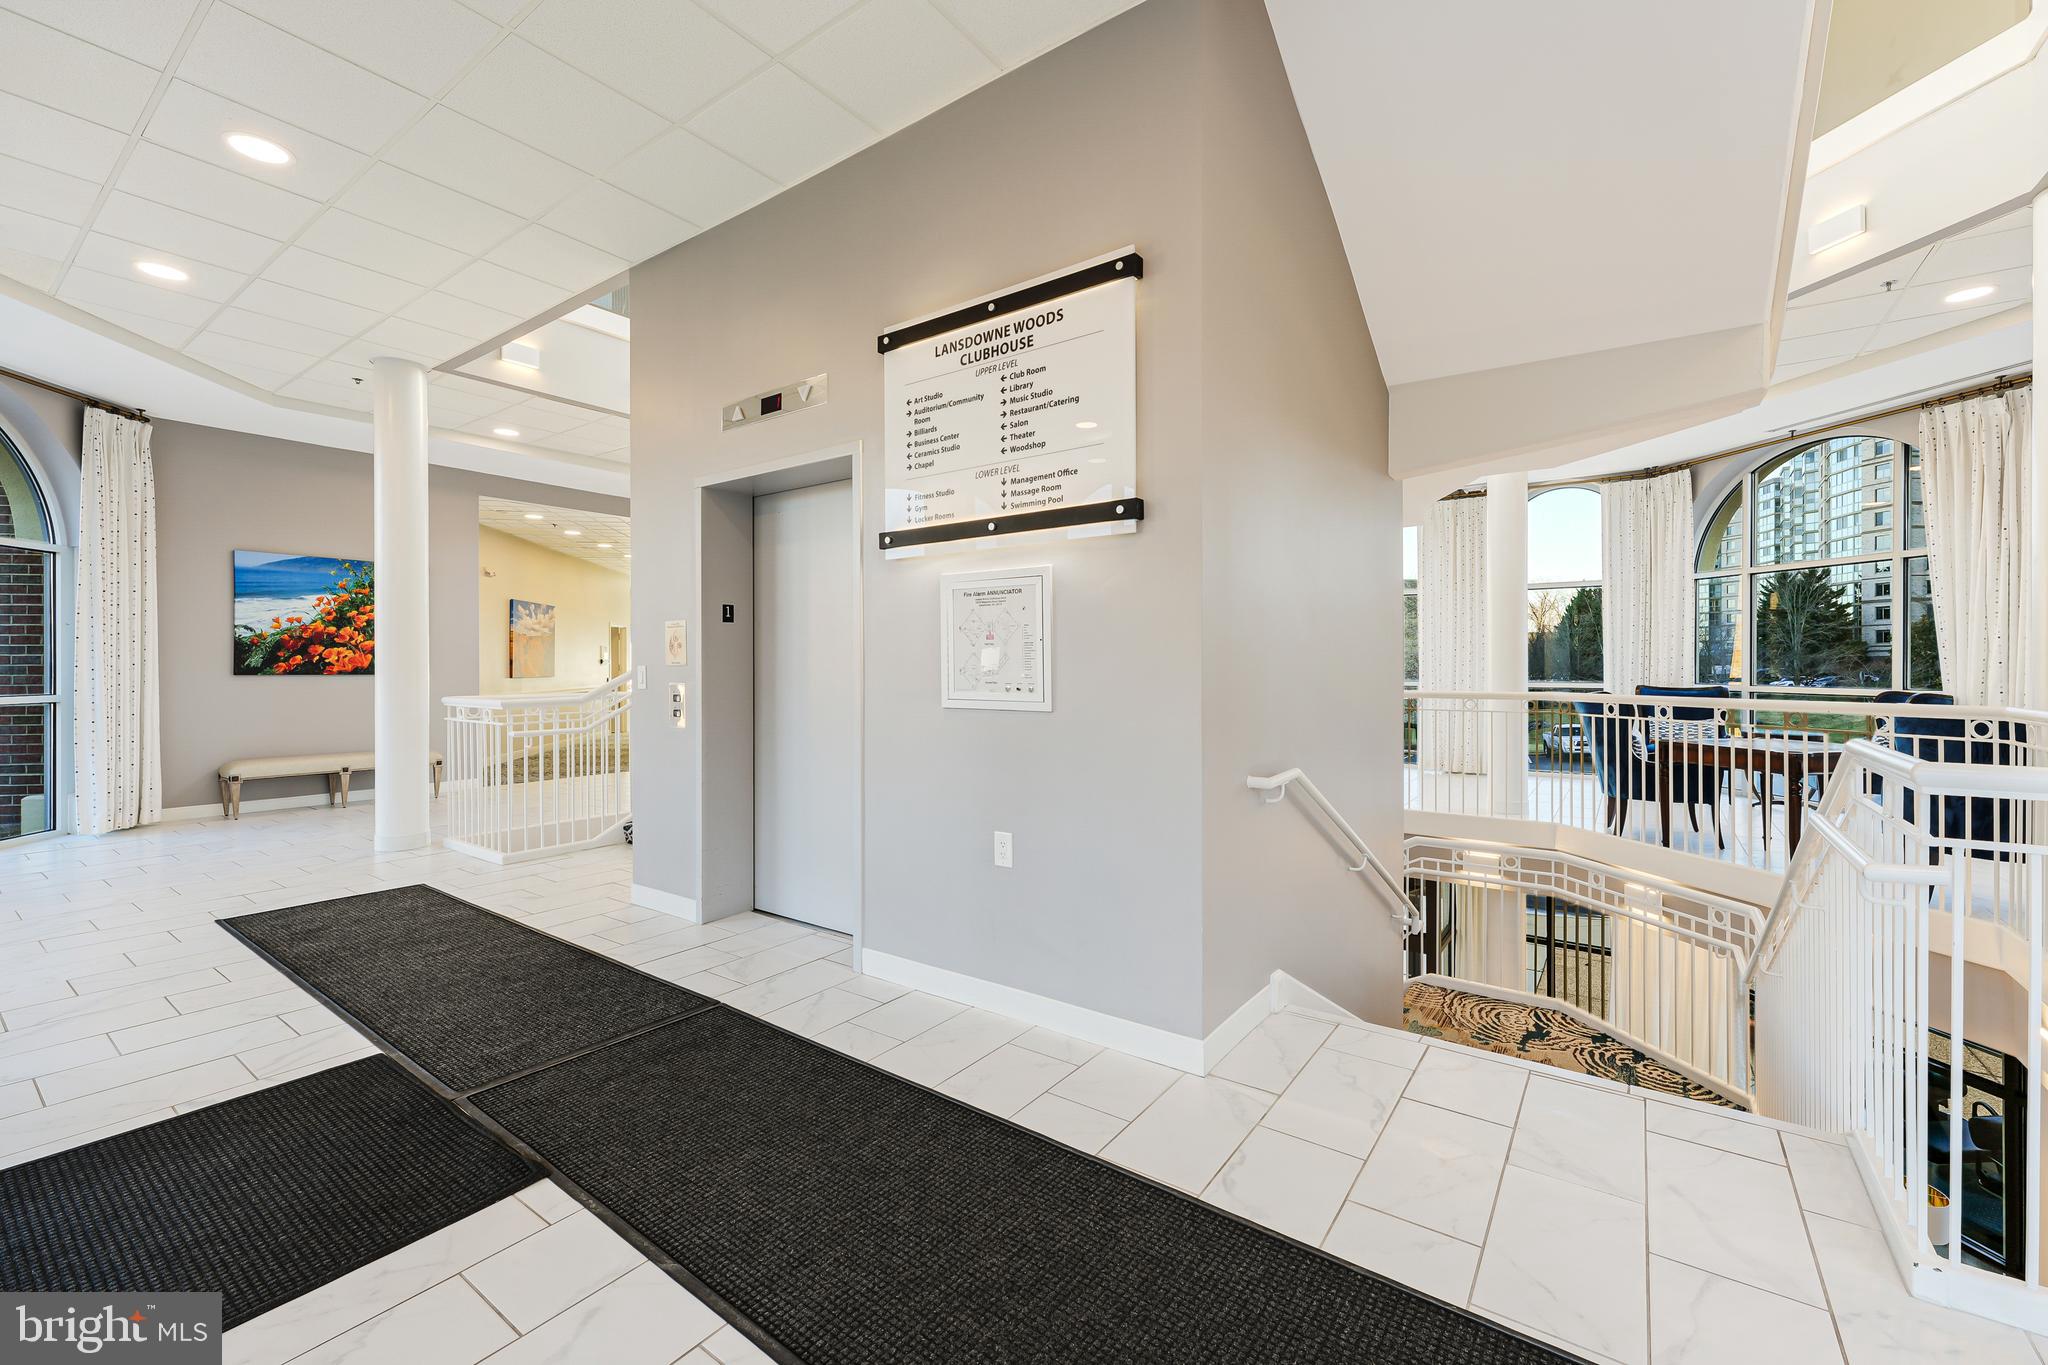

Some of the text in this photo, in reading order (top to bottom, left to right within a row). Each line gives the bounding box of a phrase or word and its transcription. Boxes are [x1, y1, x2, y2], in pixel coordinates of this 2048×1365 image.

[935, 308, 1064, 358] LANSDOWNE WOODS
[960, 335, 1034, 366] CLUBHOUSE
[976, 360, 1018, 378] UPPER LEVEL
[1010, 366, 1046, 380] Club Room
[1010, 382, 1034, 392] Library
[924, 392, 943, 402] Studio
[1010, 389, 1053, 404] Music Studio
[914, 394, 984, 415] Auditorium/Community
[1010, 396, 1080, 416] Restaurant/Catering
[914, 416, 930, 425] Room
[1010, 420, 1028, 429] Salon
[914, 426, 937, 436] Billiards
[1010, 431, 1036, 441] Theater
[914, 433, 959, 447] Business Center
[914, 444, 960, 458] Ceramics Studio
[1010, 441, 1046, 453] Woodshop
[914, 460, 934, 469] Chapel
[975, 464, 1020, 479] LOWER LEVEL
[1010, 467, 1078, 485] Management Office
[914, 489, 955, 501] Fitness Studio
[1010, 484, 1062, 497] Massage Room
[1010, 495, 1064, 510] Swimming Pool
[914, 515, 933, 523] Locker
[726, 606, 730, 617] 1
